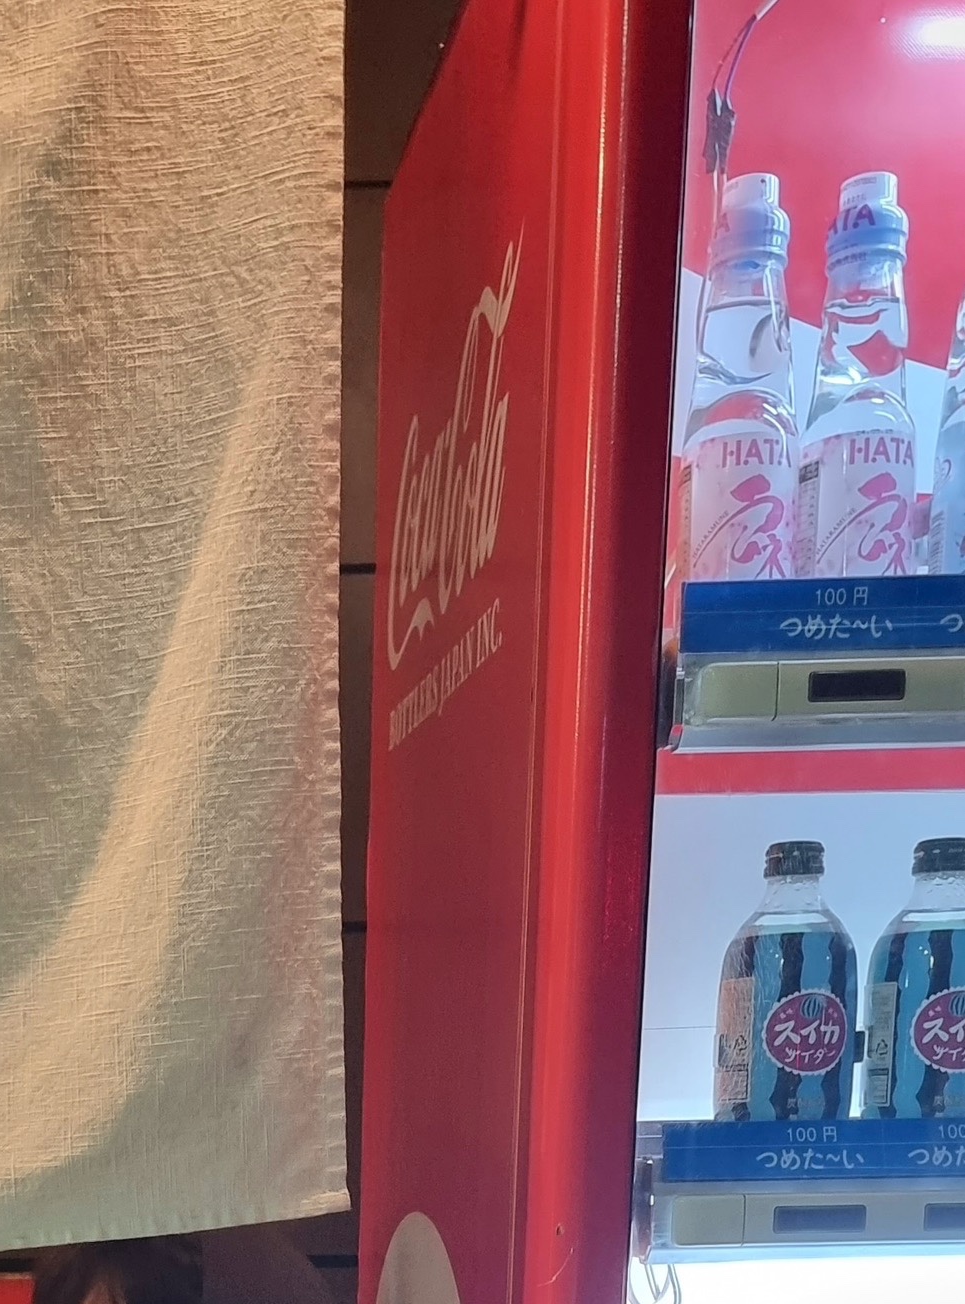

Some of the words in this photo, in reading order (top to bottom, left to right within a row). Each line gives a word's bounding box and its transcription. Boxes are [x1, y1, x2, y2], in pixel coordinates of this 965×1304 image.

[388, 215, 525, 671] Coca-Cola
[848, 437, 914, 467] HATA
[815, 588, 847, 606] 100
[853, 586, 868, 606] 円
[773, 1019, 841, 1047] スイカ
[786, 1127, 817, 1142] 100
[823, 1126, 837, 1142] 円
